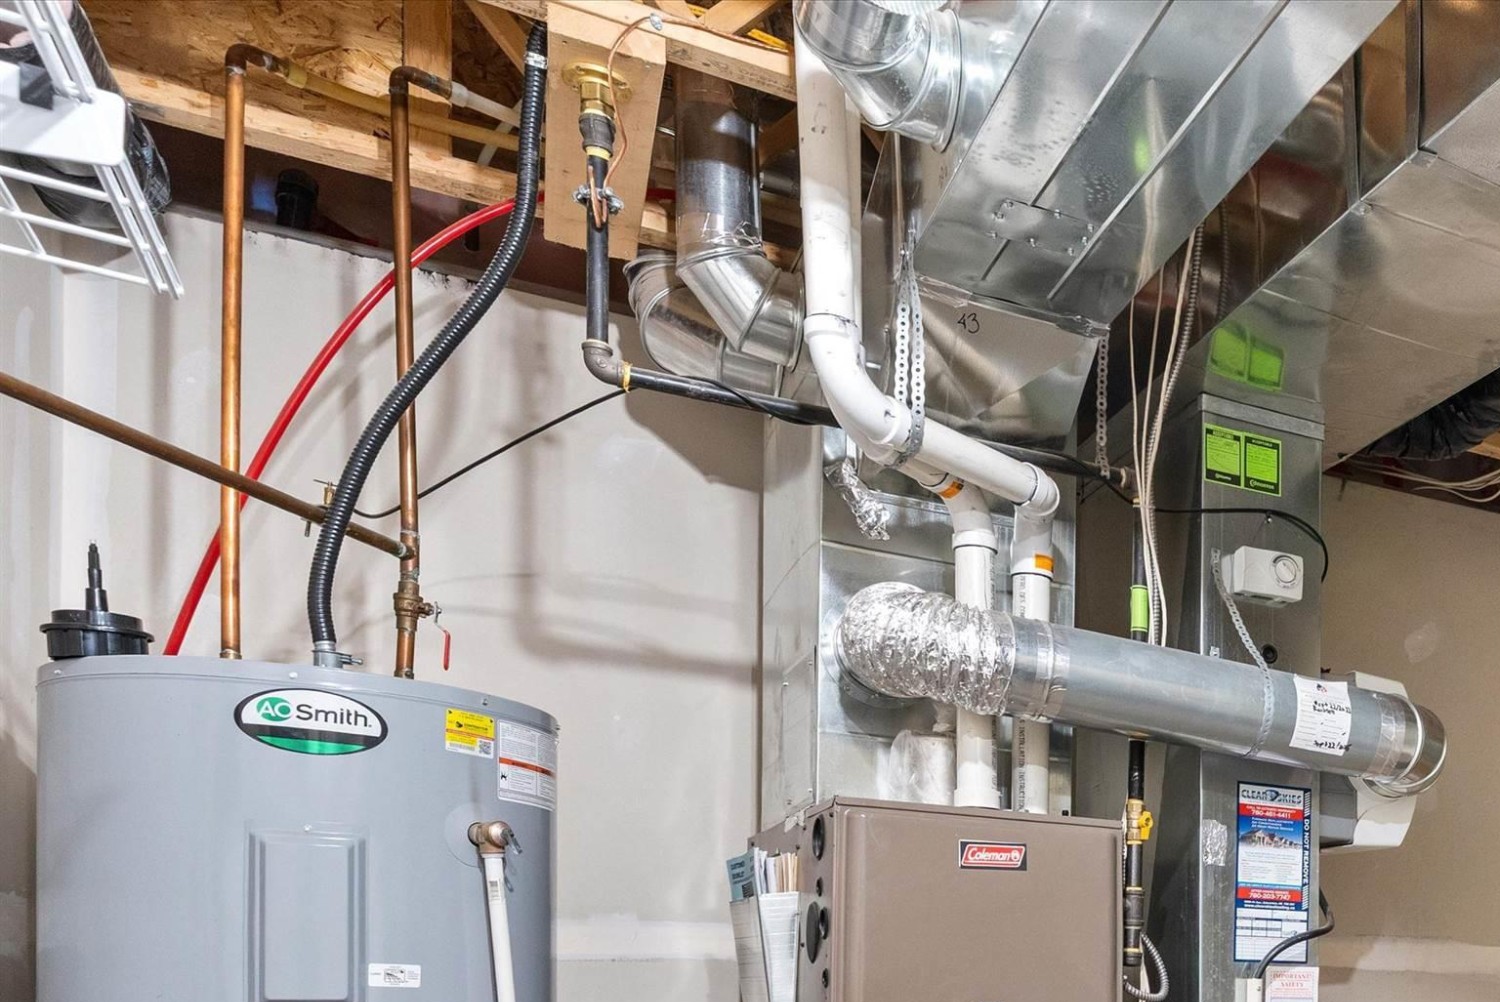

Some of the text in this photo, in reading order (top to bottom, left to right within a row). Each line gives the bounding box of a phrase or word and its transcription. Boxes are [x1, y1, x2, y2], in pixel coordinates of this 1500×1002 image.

[957, 312, 980, 334] 43
[258, 701, 293, 718] AO
[1304, 819, 1310, 831] DO
[967, 847, 1010, 861] Coleman
